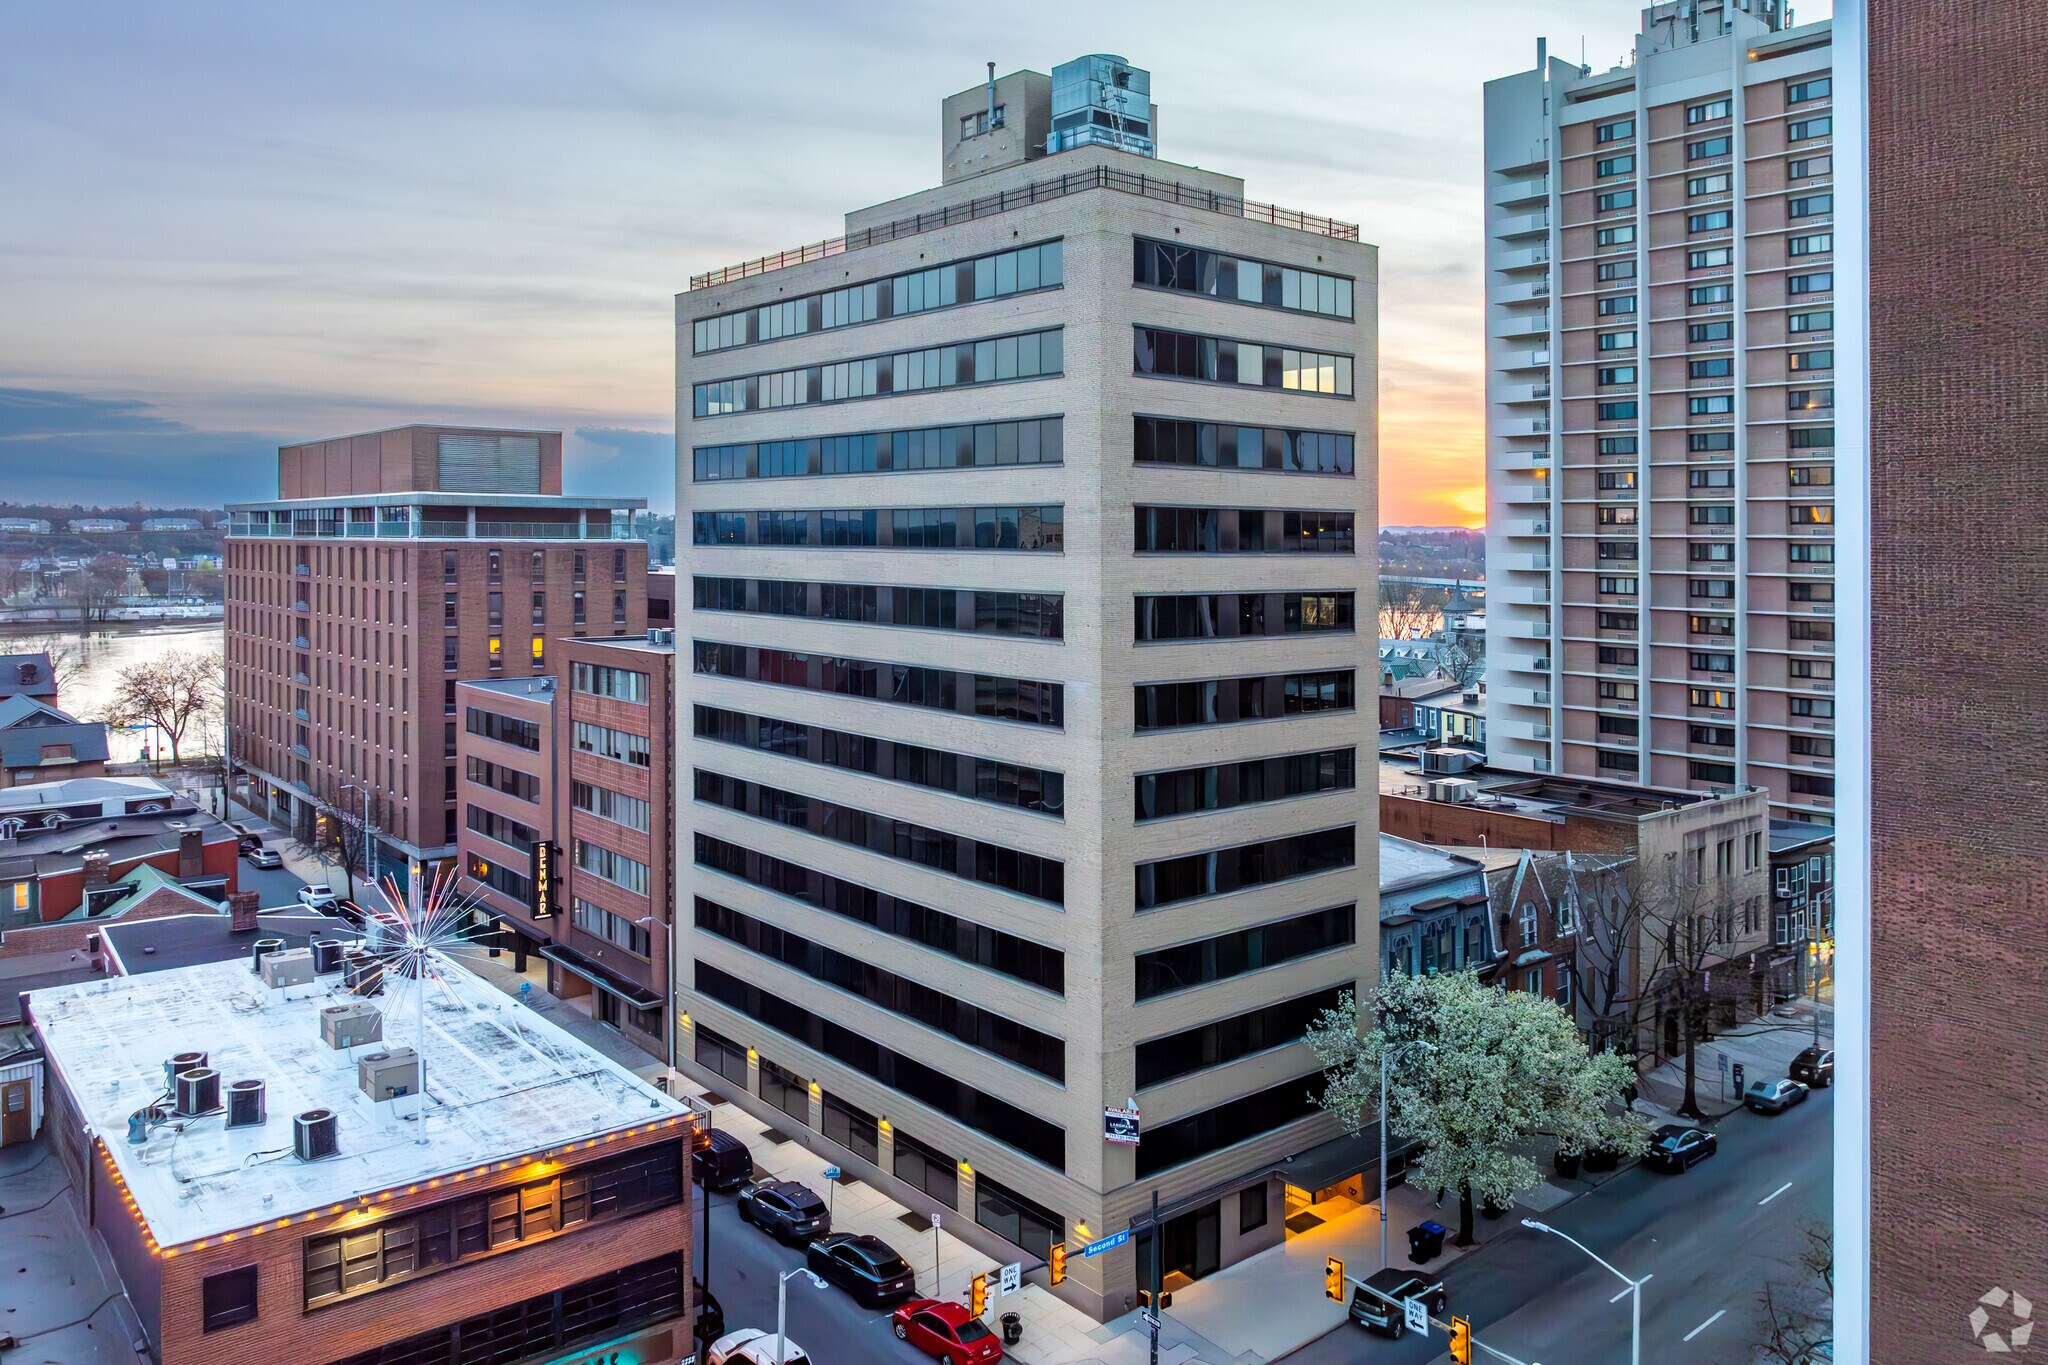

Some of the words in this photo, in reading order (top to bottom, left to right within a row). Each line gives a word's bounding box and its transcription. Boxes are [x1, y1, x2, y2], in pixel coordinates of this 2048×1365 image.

[539, 846, 547, 914] DENMAR
[1088, 1237, 1115, 1254] Second
[1117, 1234, 1126, 1243] St
[1004, 1266, 1017, 1276] ONE
[1004, 1273, 1017, 1284] WAY
[1409, 1301, 1423, 1314] ONE
[1409, 1308, 1423, 1320] WAY
